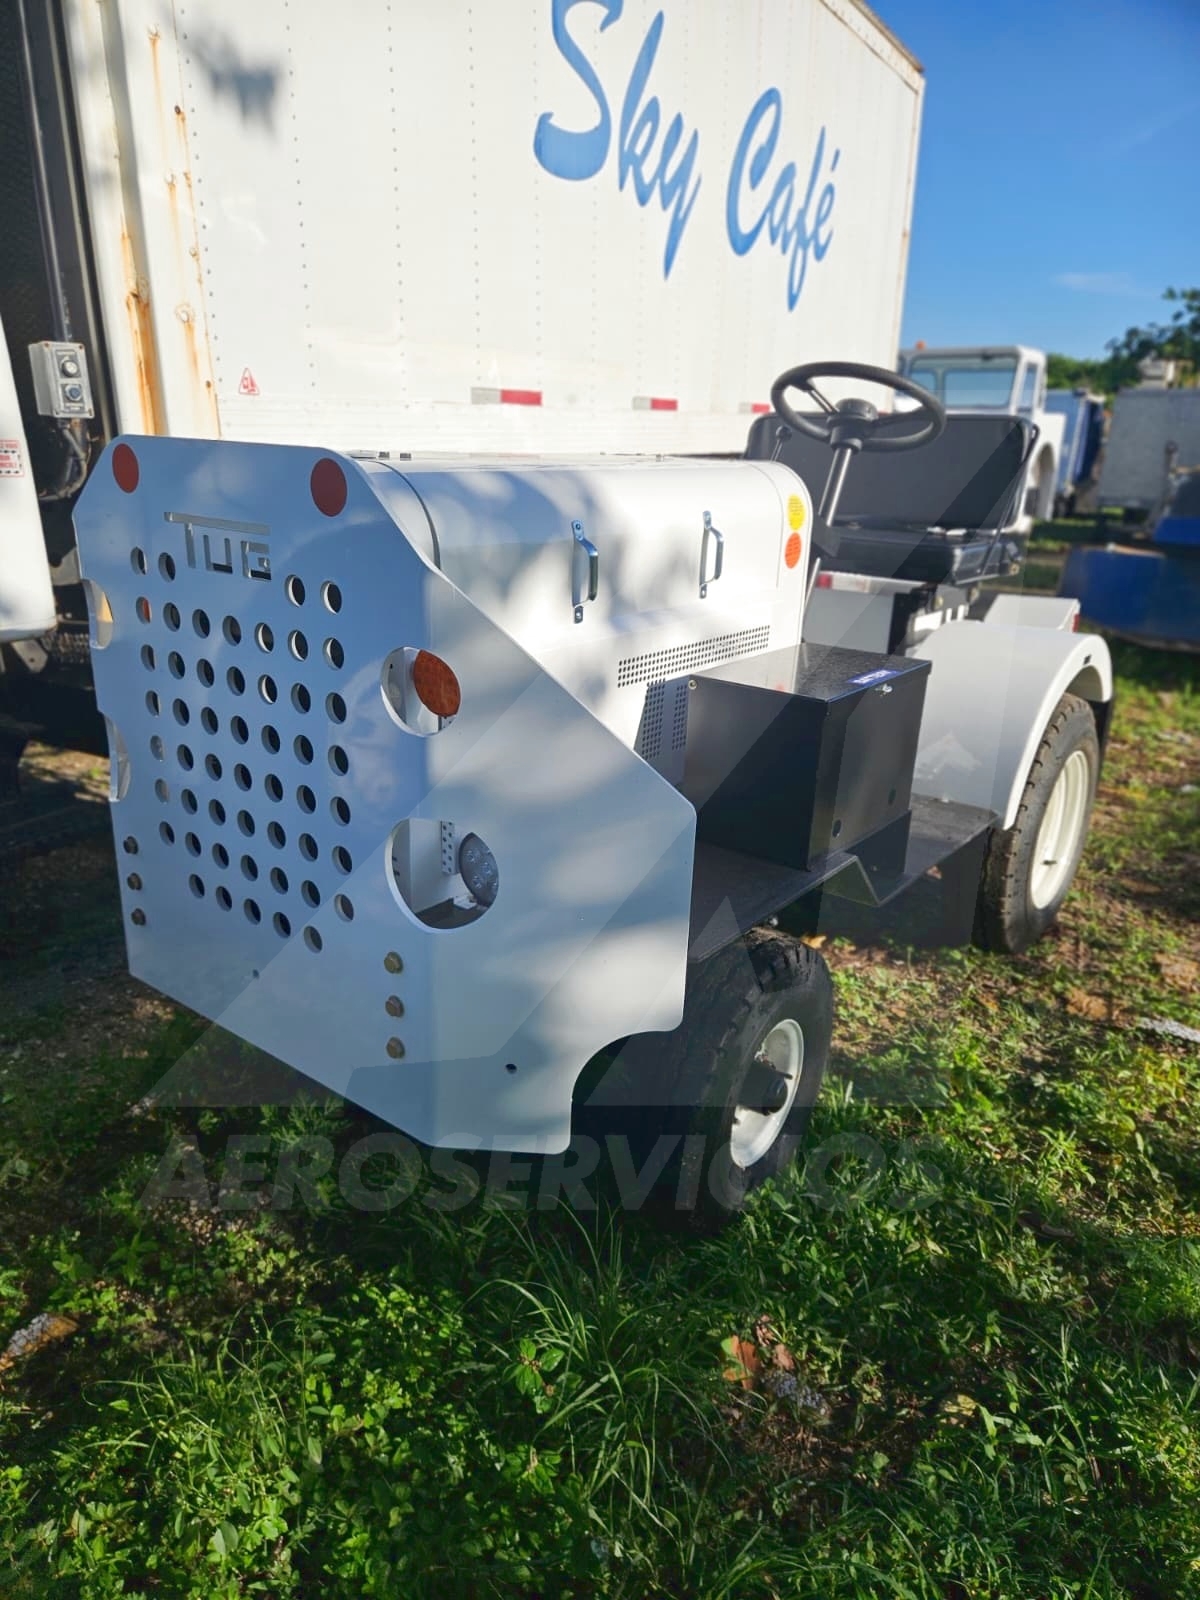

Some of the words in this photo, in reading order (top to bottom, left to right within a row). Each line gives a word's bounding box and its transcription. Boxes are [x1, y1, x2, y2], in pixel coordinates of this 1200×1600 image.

[533, 0, 702, 280] Sky
[726, 86, 840, 312] Café
[163, 511, 272, 581] TUG
